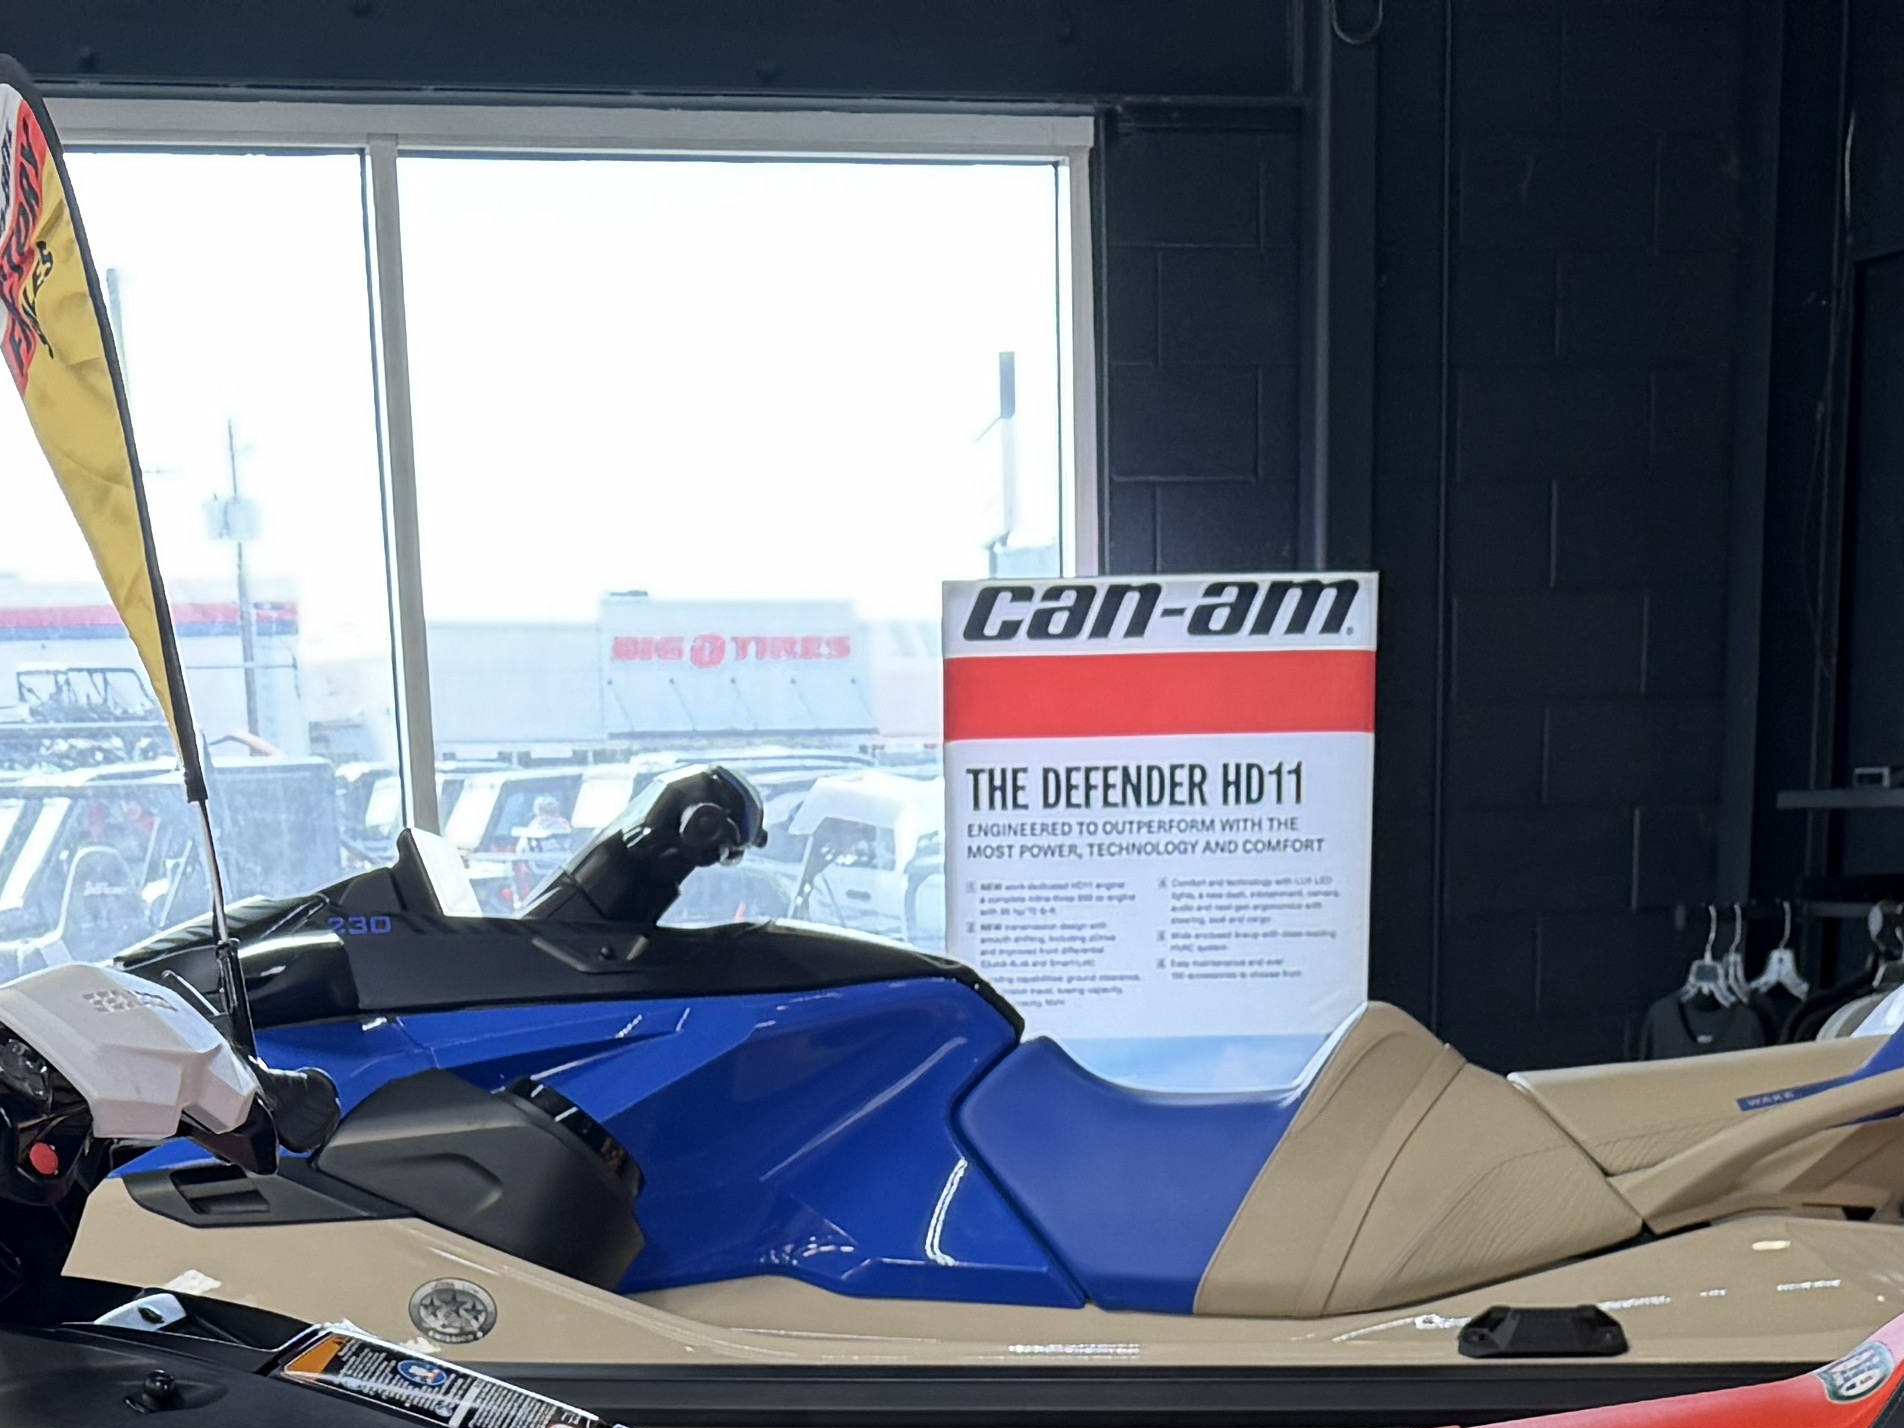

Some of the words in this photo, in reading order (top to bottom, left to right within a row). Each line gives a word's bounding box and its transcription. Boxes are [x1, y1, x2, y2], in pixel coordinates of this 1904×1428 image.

[963, 579, 1360, 641] can-am
[612, 636, 684, 661] BIG
[690, 634, 726, 669] O
[731, 636, 850, 660] TIRES
[967, 766, 1029, 811] THE
[1043, 762, 1208, 810] DEFENDER
[1222, 760, 1303, 805] HD11
[967, 821, 1072, 838] ENGINEERED
[1077, 820, 1097, 836] TO
[1102, 819, 1215, 835] OUTPERFORM
[1220, 817, 1262, 833] WITH
[1268, 816, 1298, 832] THE
[967, 843, 1014, 860] MOST
[1019, 843, 1082, 860] POWER,
[1088, 839, 1198, 857] TECHNOLOGY
[1203, 839, 1238, 854] AND
[1242, 838, 1325, 853] COMFORT
